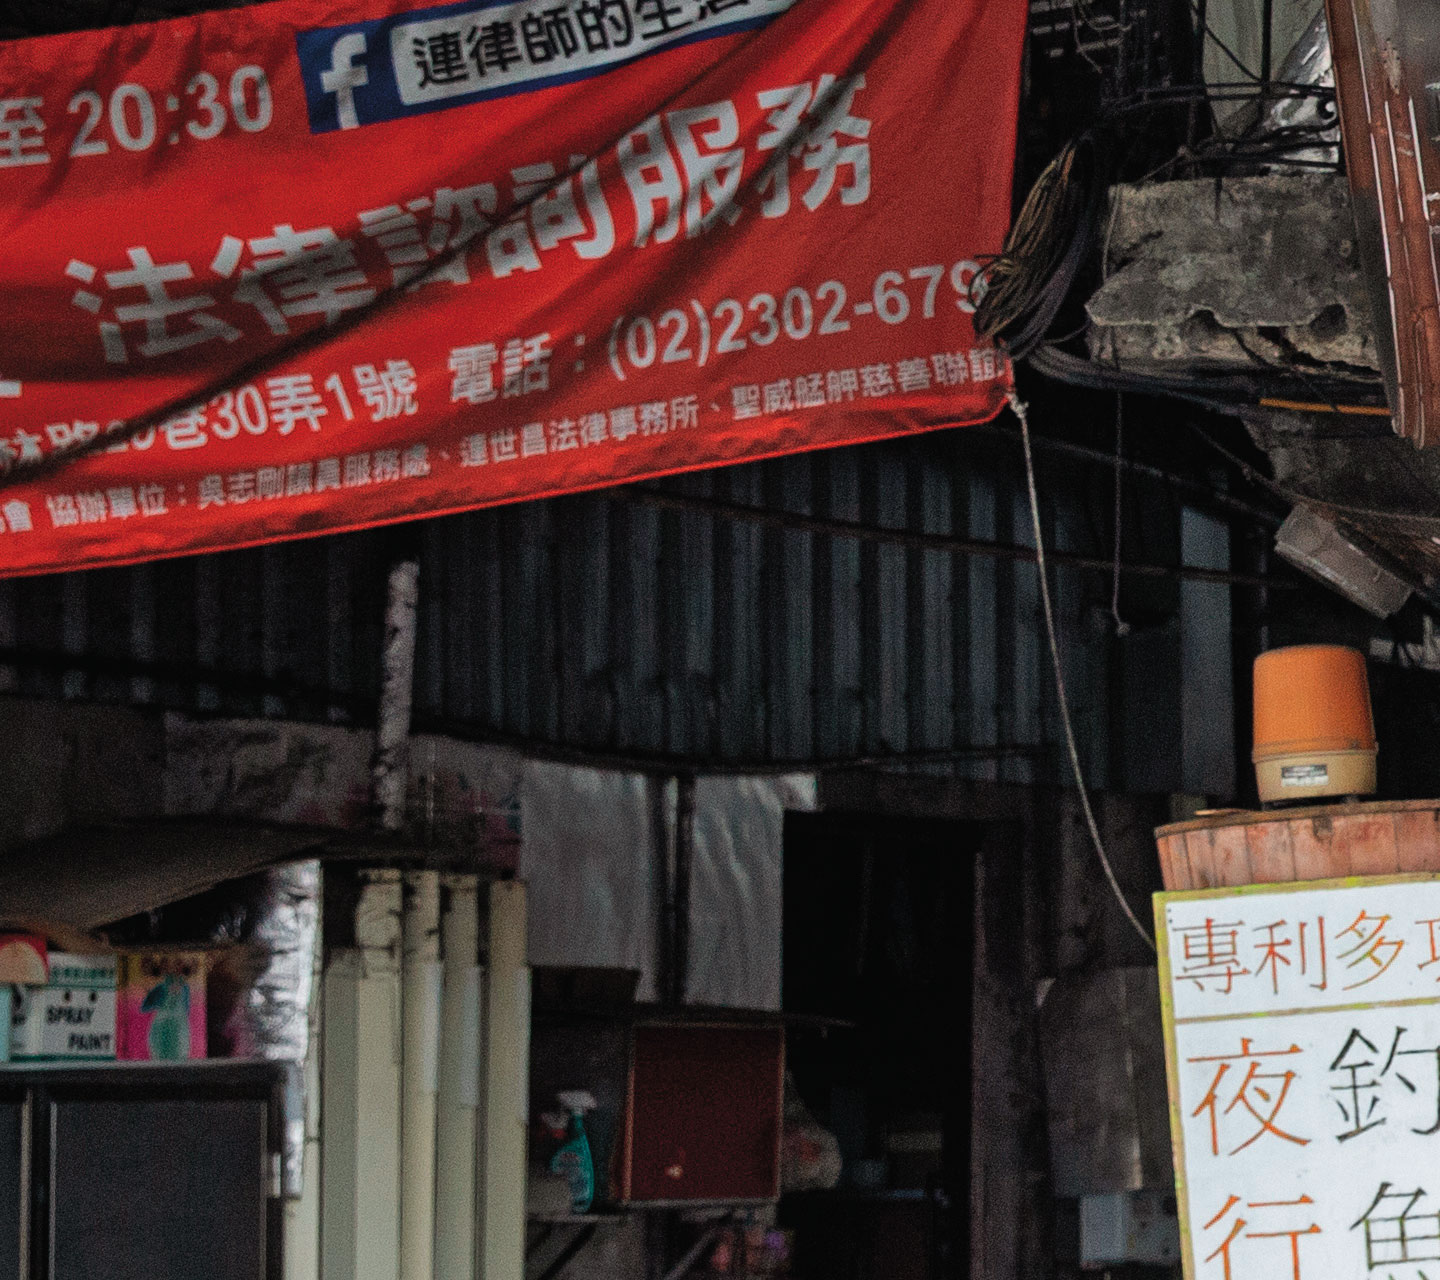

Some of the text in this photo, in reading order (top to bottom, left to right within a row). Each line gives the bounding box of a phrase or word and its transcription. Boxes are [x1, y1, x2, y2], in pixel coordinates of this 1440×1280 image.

[67, 64, 274, 158] 20:30
[66, 71, 874, 364] 法律諮詢服務
